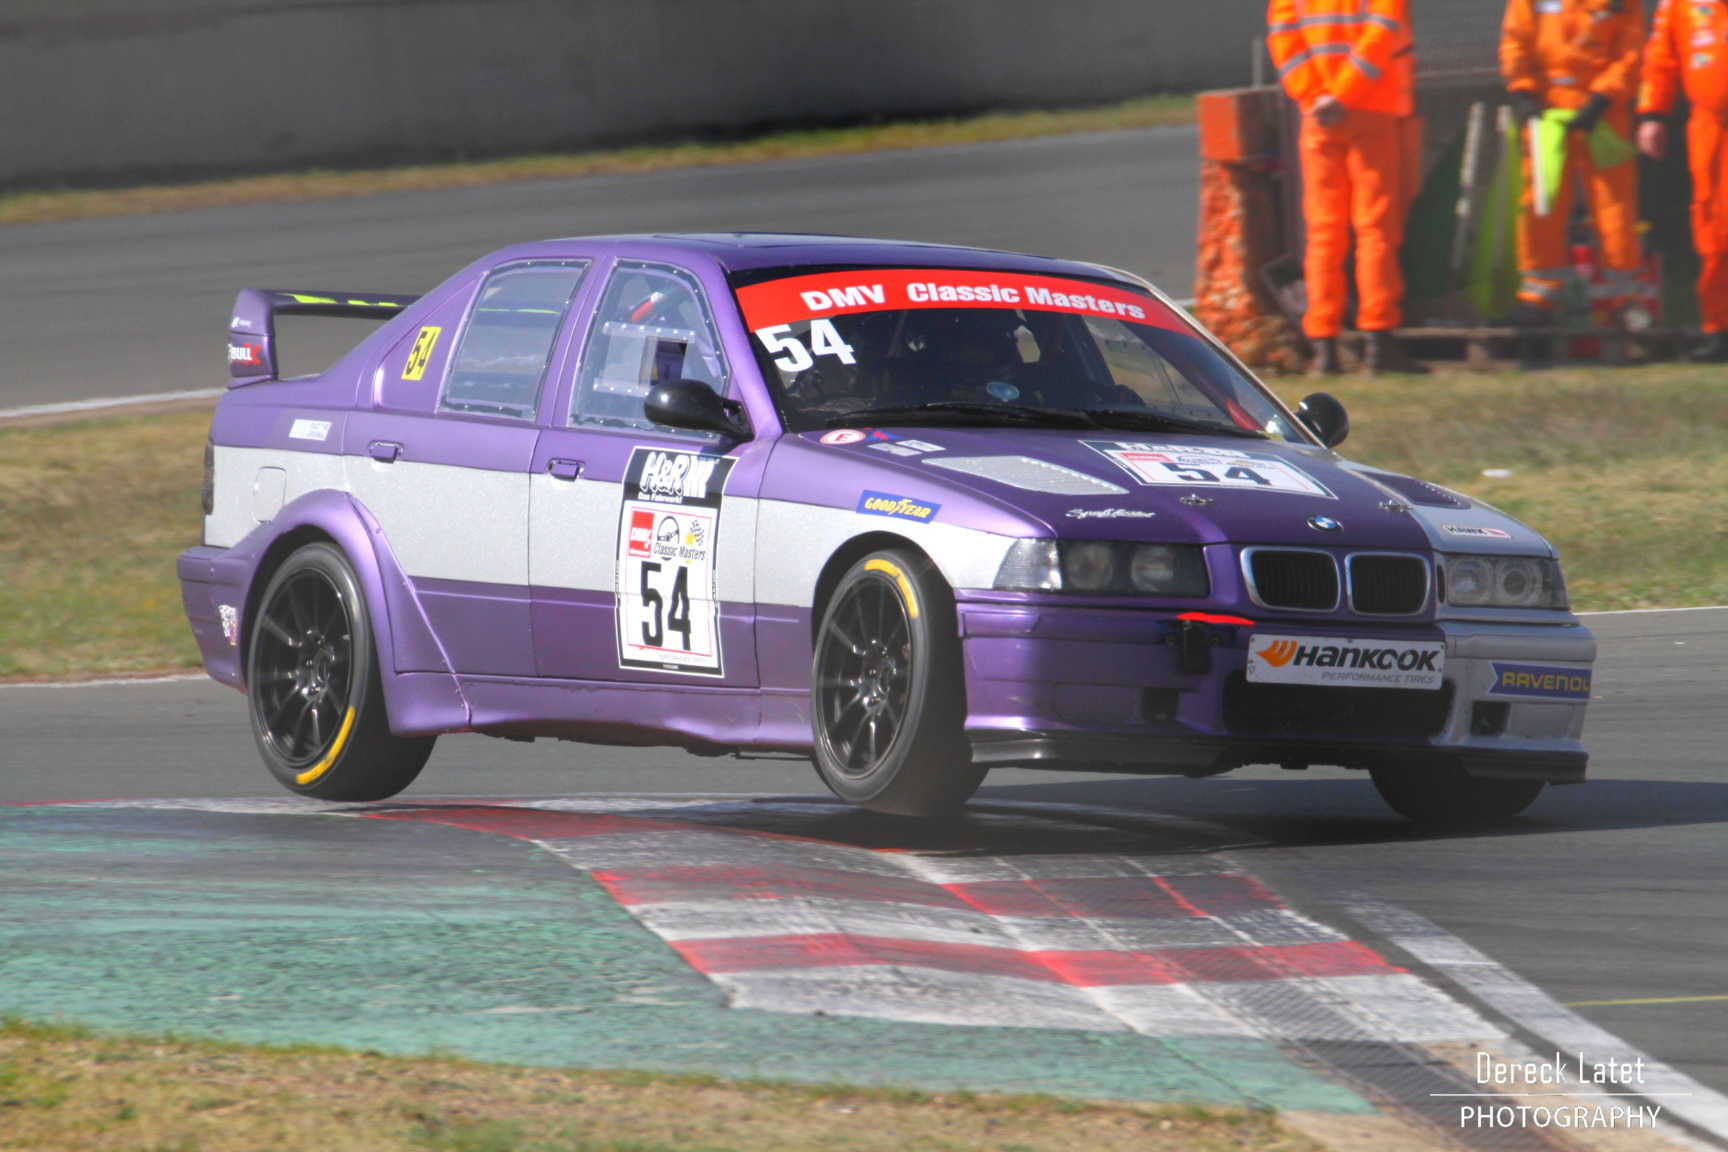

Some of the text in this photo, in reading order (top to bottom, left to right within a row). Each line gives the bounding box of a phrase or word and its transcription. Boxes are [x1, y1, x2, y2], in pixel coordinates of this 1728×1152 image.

[801, 282, 1145, 319] DMV Classic Masters
[755, 318, 857, 373] 54
[1160, 462, 1271, 486] 54
[641, 560, 691, 651] 54
[1321, 671, 1434, 684] PERFORMANCE TIRES
